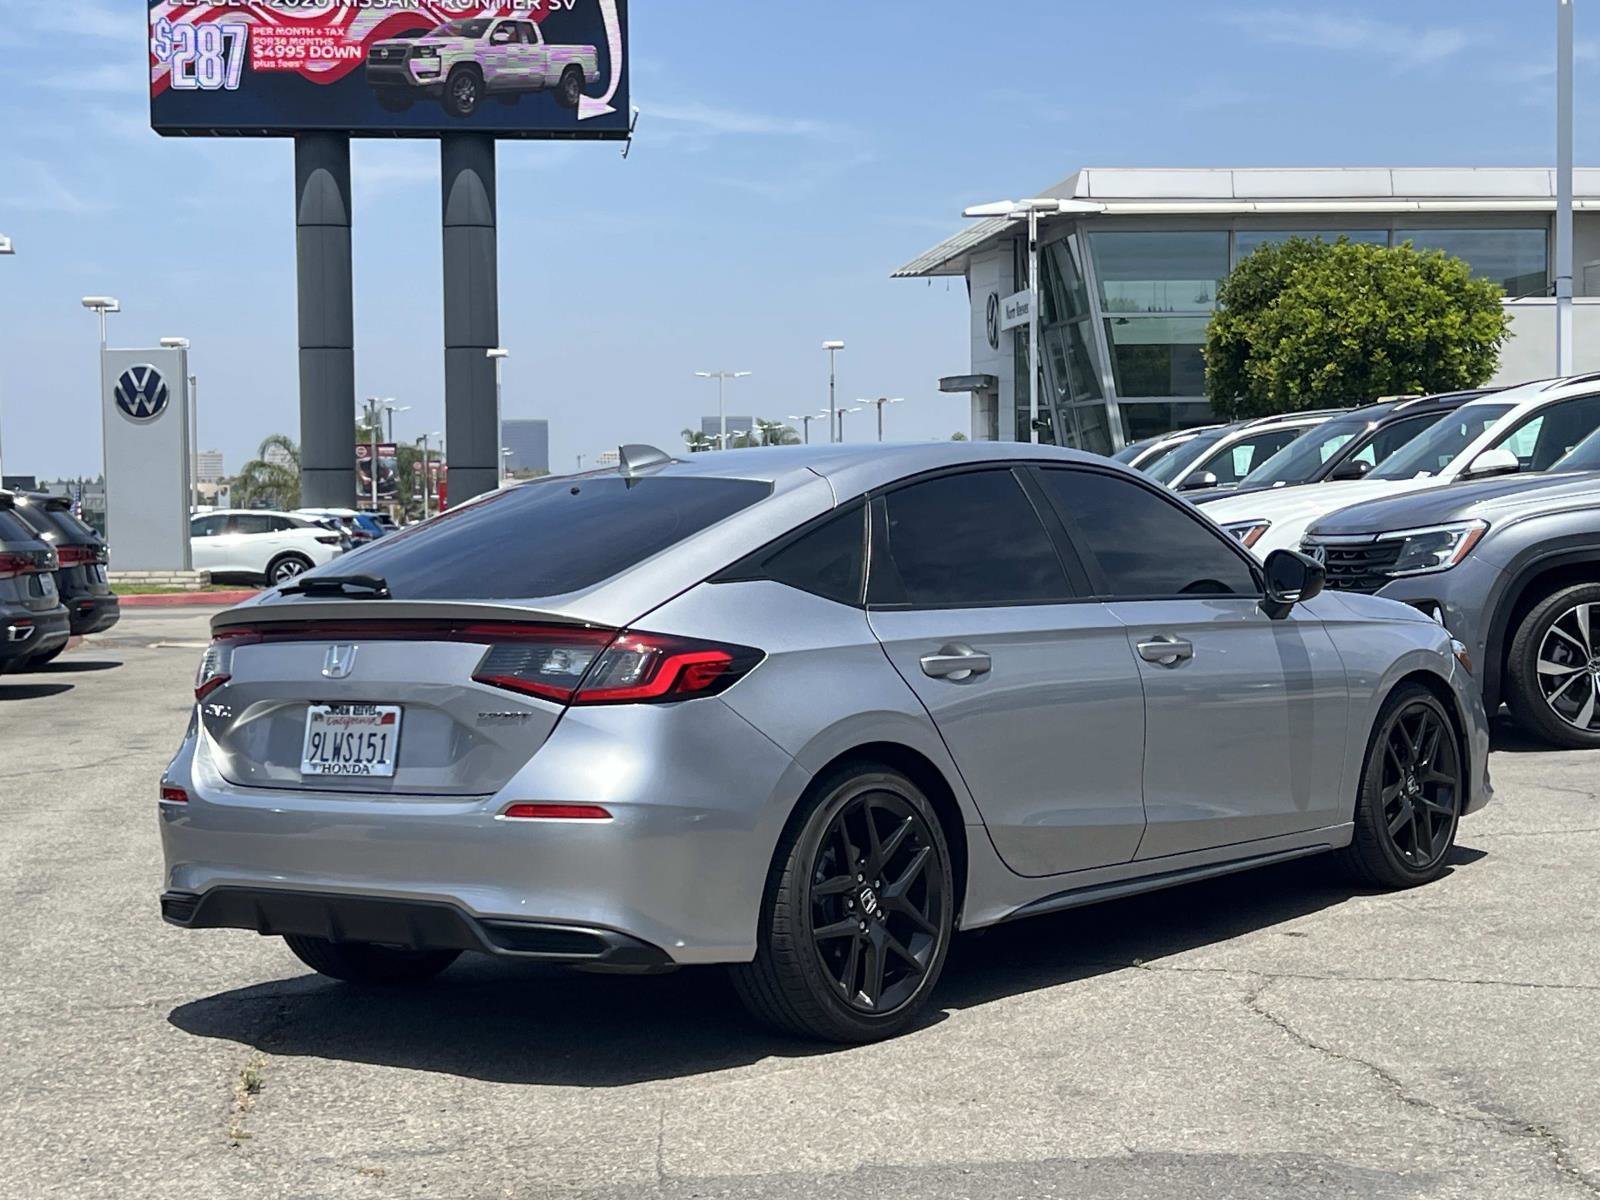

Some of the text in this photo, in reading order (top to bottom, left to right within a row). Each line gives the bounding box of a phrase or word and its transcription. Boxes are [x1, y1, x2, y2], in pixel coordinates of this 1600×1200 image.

[252, 27, 274, 36] PER
[275, 27, 314, 36] MONTH
[324, 27, 345, 36] TAX
[289, 37, 334, 46] MONTHS
[152, 17, 248, 90] $287
[253, 45, 361, 58] $4995 DOWN
[253, 60, 276, 70] plus
[309, 731, 388, 765] 9LWS151
[321, 763, 371, 775] HONDA
